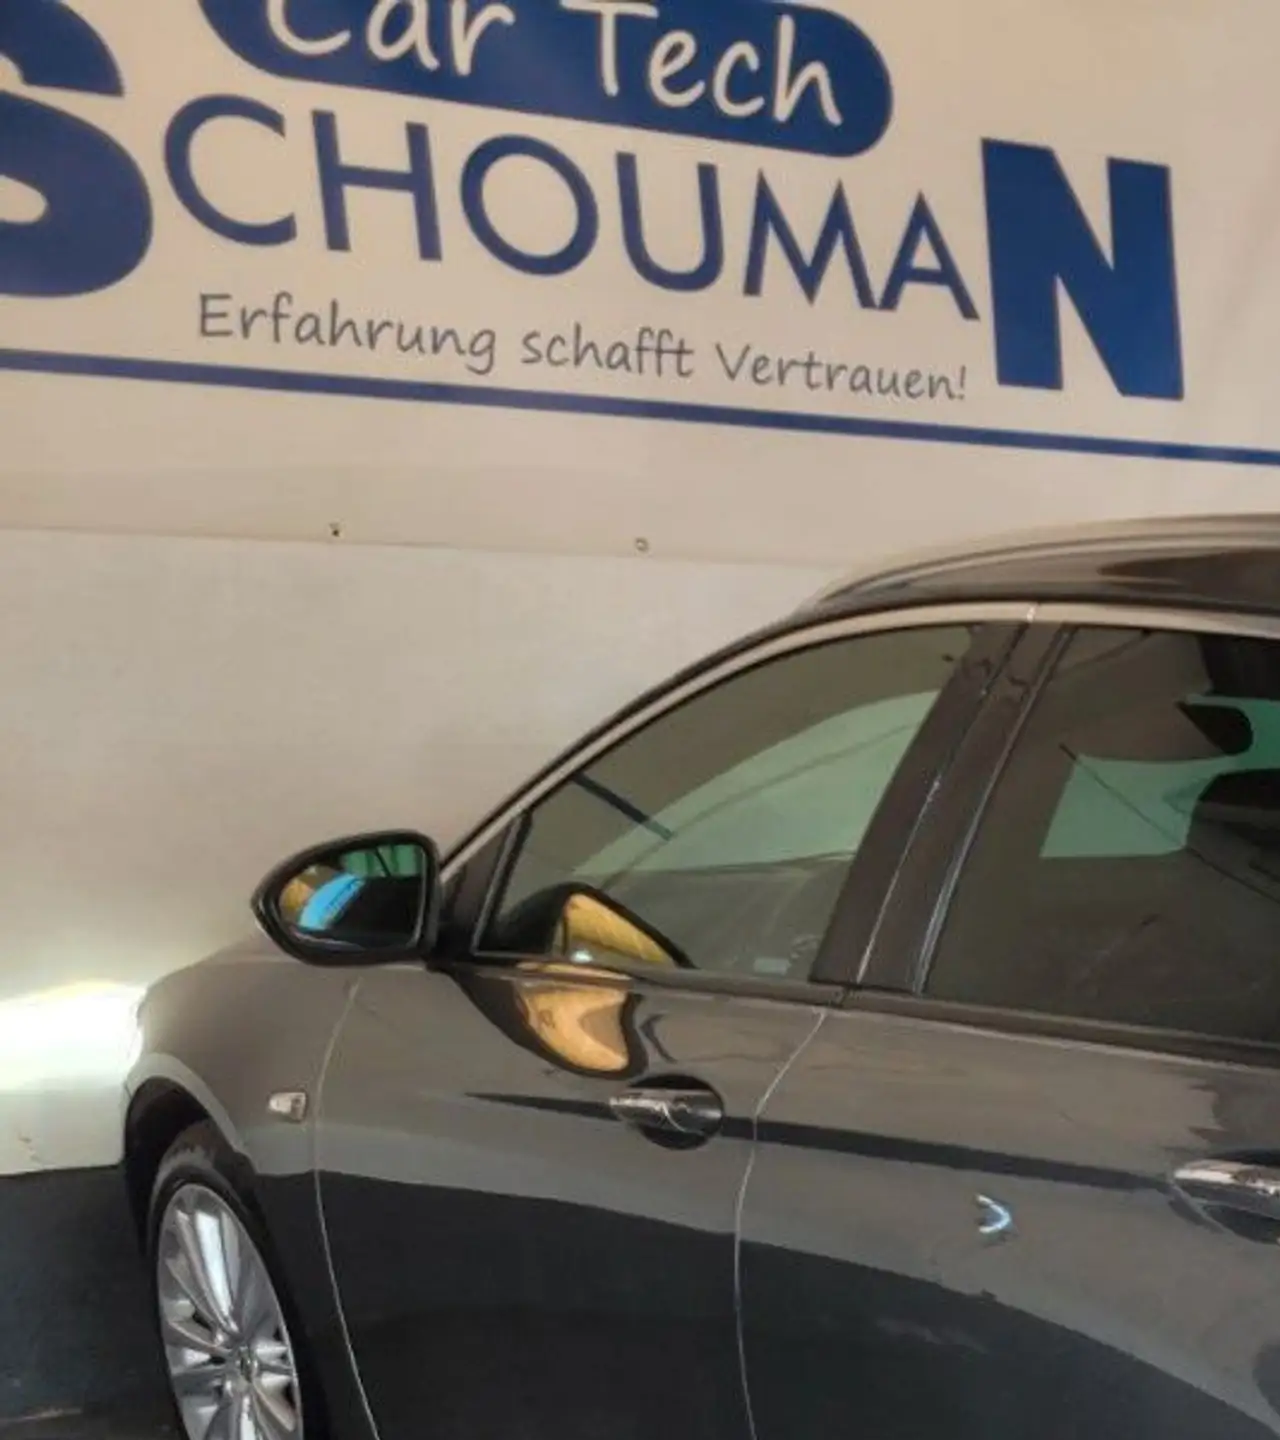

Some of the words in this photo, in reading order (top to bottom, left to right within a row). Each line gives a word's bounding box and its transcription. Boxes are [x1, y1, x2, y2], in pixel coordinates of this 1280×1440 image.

[266, 0, 515, 76] Car
[558, 0, 843, 126] Tech
[199, 290, 497, 376] Erfahrung
[520, 323, 695, 378] schafft
[715, 343, 967, 400] Vertrauen!
